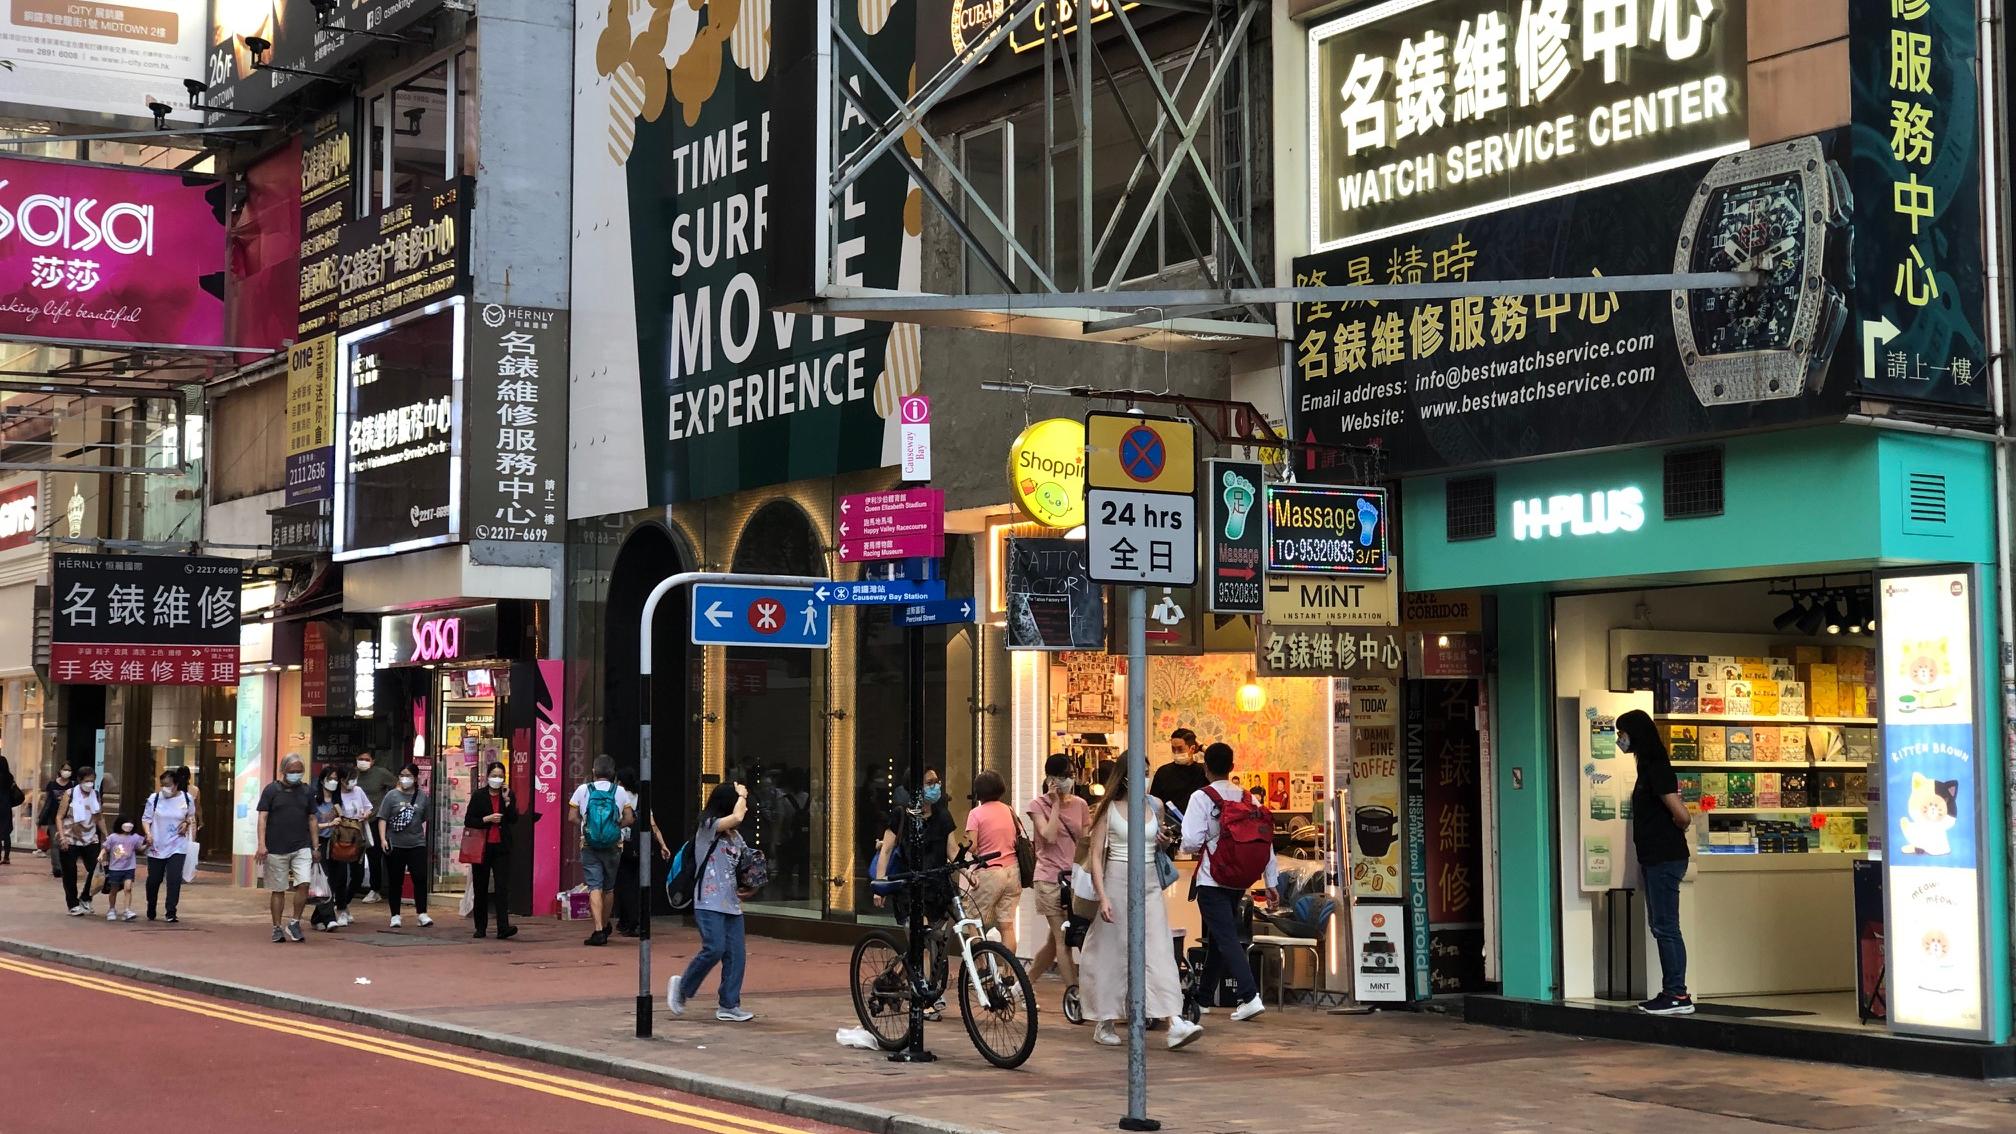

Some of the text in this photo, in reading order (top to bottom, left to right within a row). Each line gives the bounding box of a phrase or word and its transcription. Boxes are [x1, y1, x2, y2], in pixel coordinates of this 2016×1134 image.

[101, 21, 148, 35] MIDTOWN
[960, 2, 993, 29] CUBA
[209, 49, 233, 88] 26/F
[1339, 0, 1716, 157] 名錶維修中心
[842, 75, 866, 132] A
[1338, 75, 1729, 211] WATCH SERVICE CENTER
[672, 120, 748, 195] TIME
[31, 255, 100, 293] 莎莎
[43, 300, 73, 324] life
[75, 303, 142, 328] beautiful
[508, 306, 555, 323] HÉRNLY
[1298, 267, 1621, 382] 名錶維修服務中心
[292, 346, 313, 371] one
[1886, 350, 1974, 387] 請上一樓
[1301, 332, 1656, 413] Email address: info@bestwatchservice.com
[669, 347, 865, 441] EXPERIENCE
[1340, 364, 1656, 433] Website: www.bestwatchservice.com
[495, 330, 540, 525] 名錶維修服務中心
[403, 444, 428, 462] Service
[904, 430, 916, 475] Causeway
[915, 444, 926, 461] Bay
[289, 461, 326, 486] 2111 2636
[544, 479, 556, 525] 請上一樓
[864, 500, 928, 513] Queen Elizabeth Stadium
[1232, 490, 1246, 515] 足
[1513, 487, 1645, 541] H-PLUS
[1101, 500, 1183, 531] 24 hrs
[1275, 498, 1357, 537] Massage
[490, 526, 549, 542] 2217-6699
[863, 523, 928, 535] Happy Valley Racecourse
[863, 547, 904, 558] Racing Museum
[1109, 536, 1173, 574] 全日
[1218, 542, 1259, 568] Massage
[1276, 538, 1355, 563] TO:95320835
[1355, 549, 1381, 565] 3/F
[58, 556, 103, 571] HÉRNLY
[196, 565, 217, 575] 2217
[218, 565, 239, 575] 6699
[852, 592, 929, 602] Causeway Bay Station
[853, 585, 886, 594] 銅鑼灣站
[1218, 582, 1260, 604] 95320835
[61, 582, 237, 629] 名錶維修
[905, 613, 936, 623] Percival Street
[1283, 612, 1383, 620] INSTANT INSPIRATION
[1406, 602, 1470, 620] CORRIDOR
[1265, 631, 1402, 670] 名錶維修中心
[57, 660, 236, 684] 手袋維修護理
[1360, 698, 1388, 713] TODAY
[1355, 728, 1390, 741] A DAMN
[1370, 742, 1395, 756] FINE
[1891, 741, 1970, 763] KITTEN BROWN
[1352, 757, 1397, 780] COFFEE
[1411, 877, 1429, 971] Polaroid
